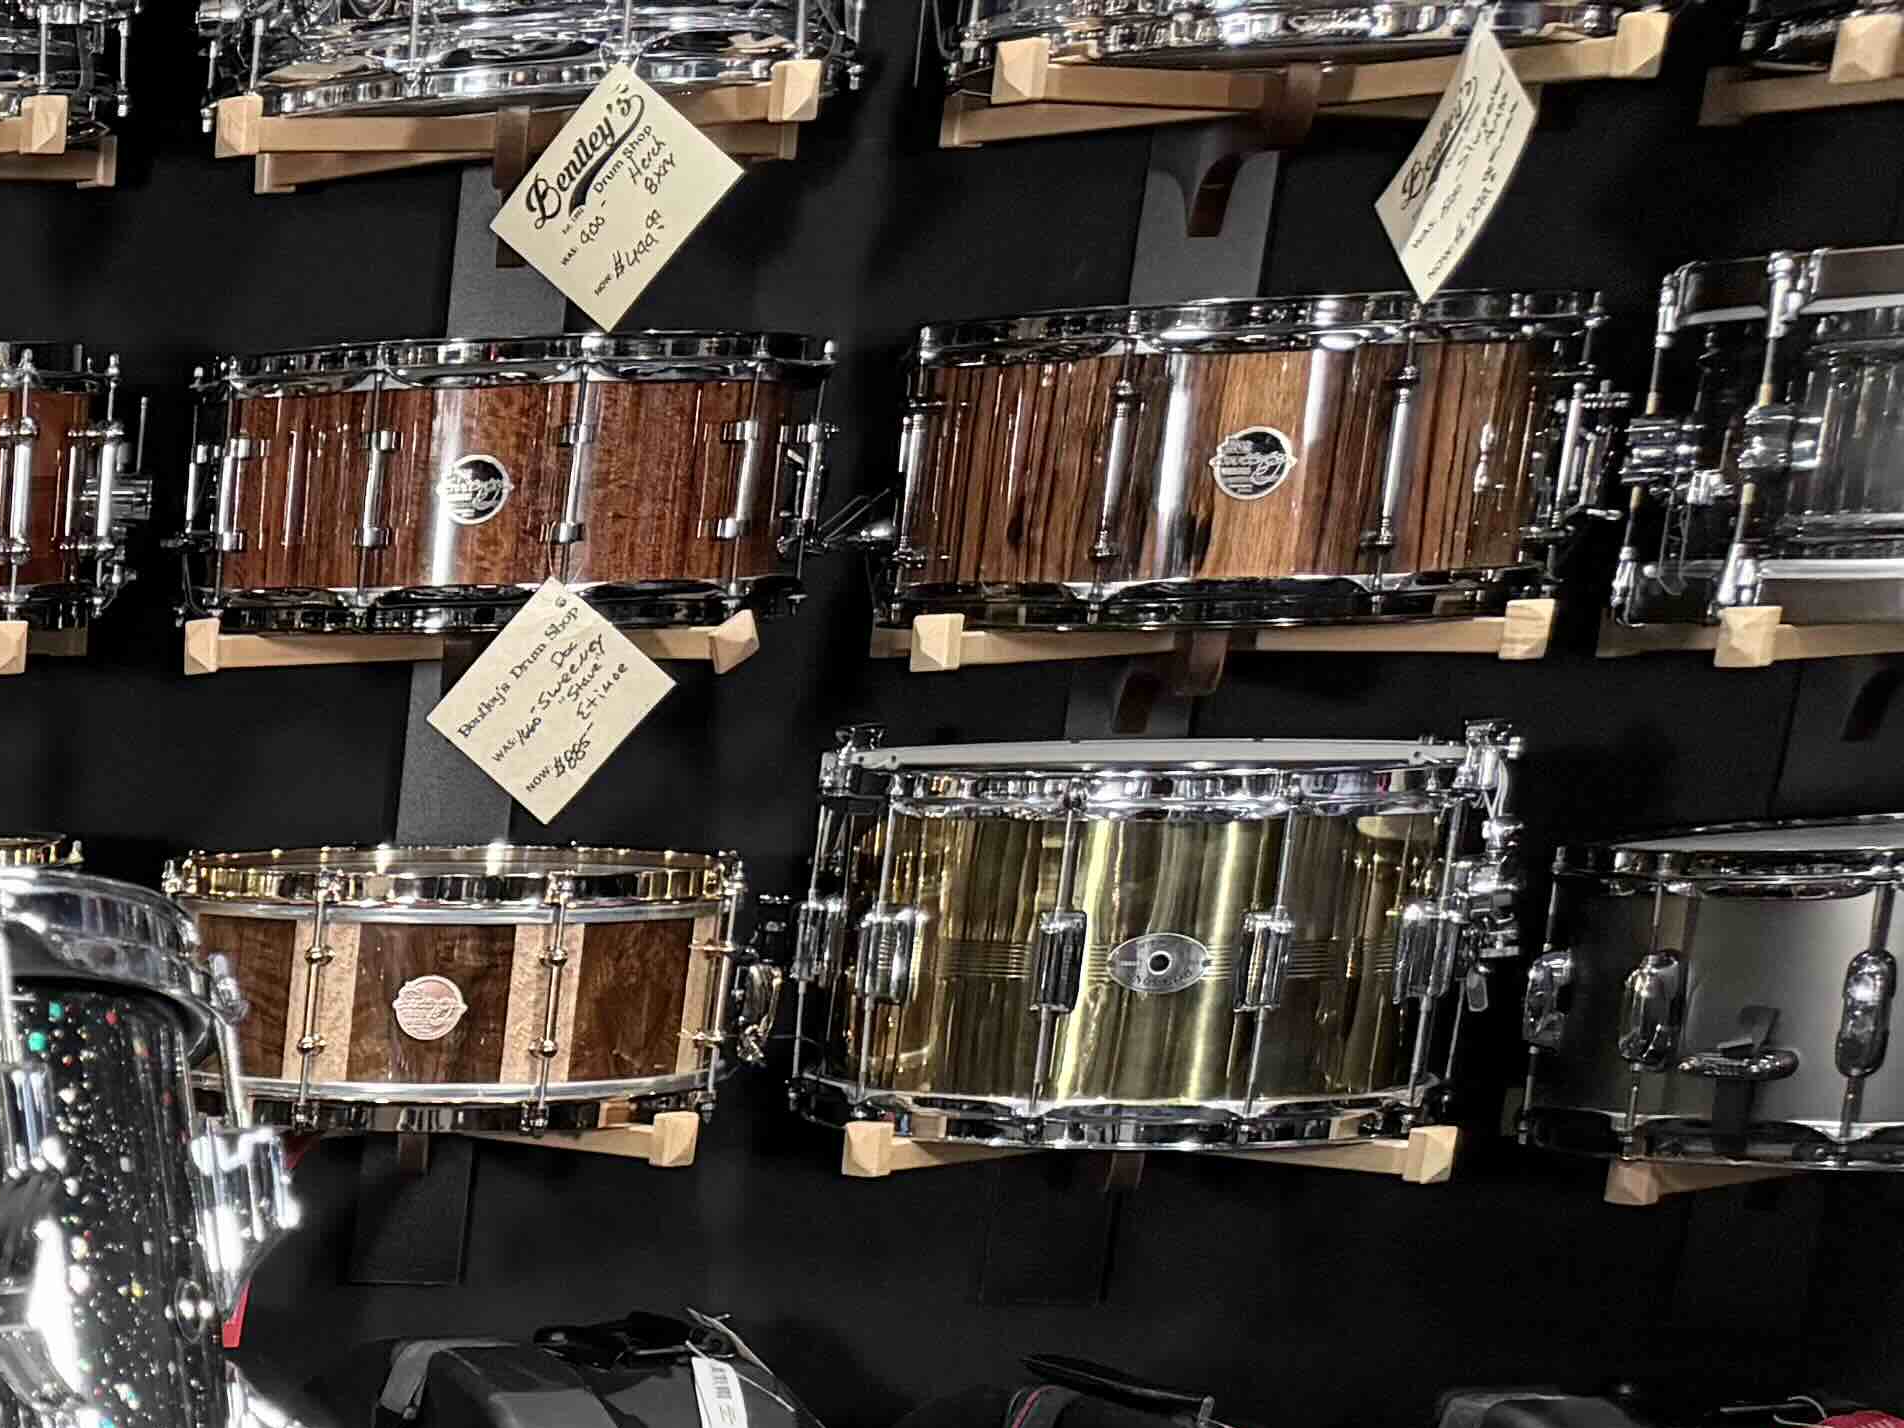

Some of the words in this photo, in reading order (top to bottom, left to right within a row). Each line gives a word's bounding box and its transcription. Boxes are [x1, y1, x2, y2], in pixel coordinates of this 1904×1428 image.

[524, 95, 635, 231] Bentley's
[593, 159, 625, 194] Drum
[622, 125, 653, 160] Shop
[456, 680, 513, 740] Bentley's
[508, 642, 548, 682] Drum
[543, 607, 581, 642] Shop
